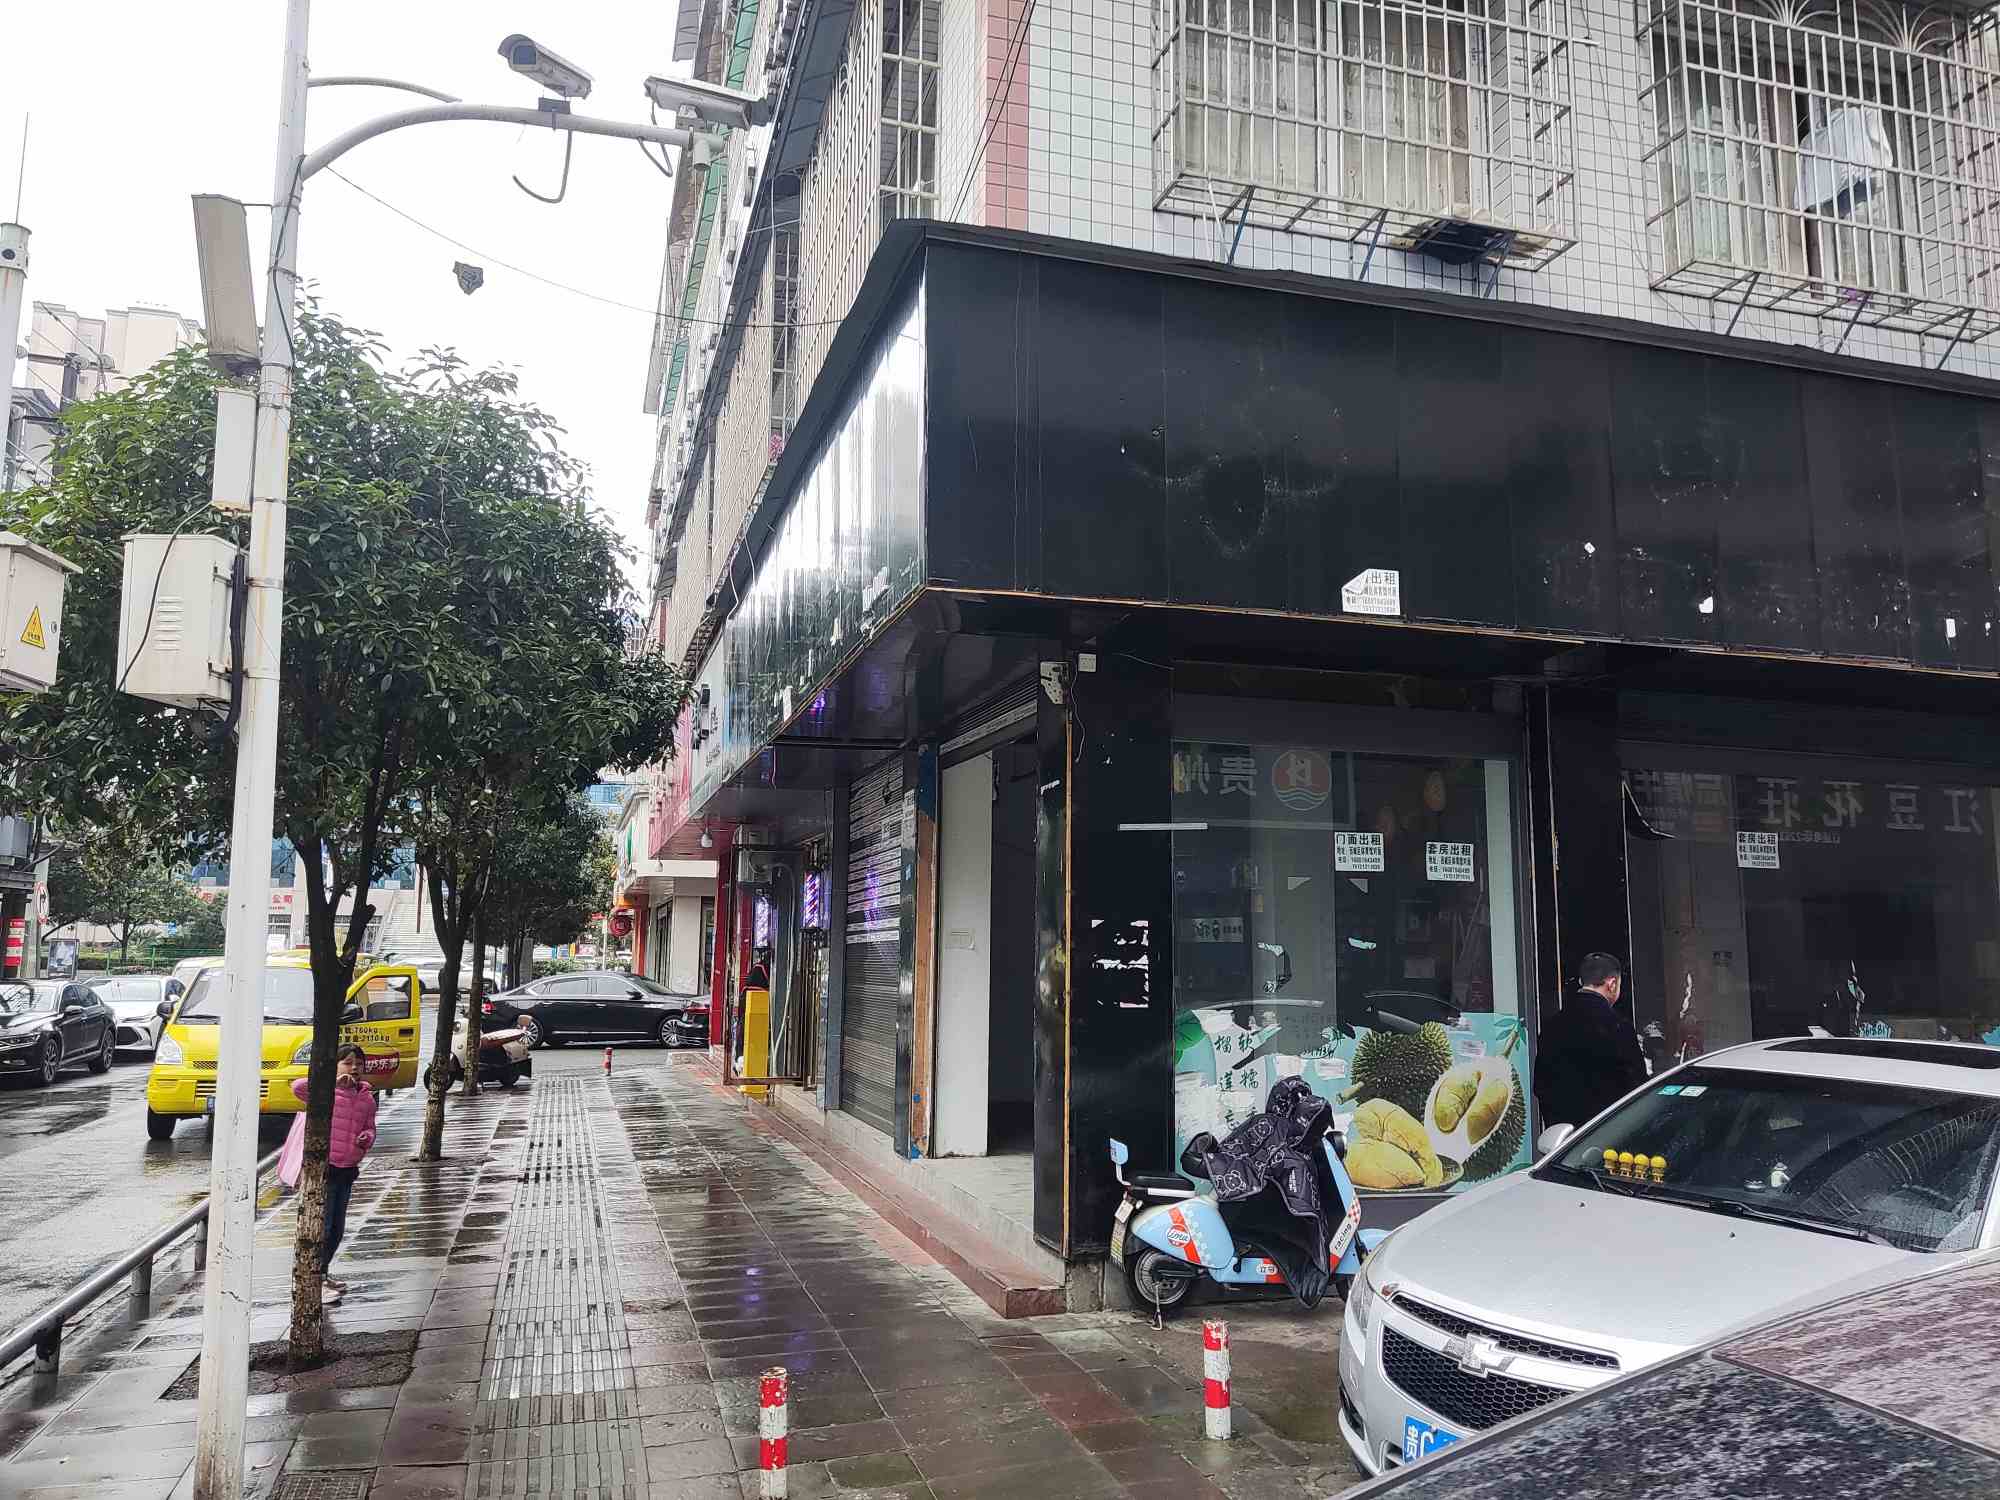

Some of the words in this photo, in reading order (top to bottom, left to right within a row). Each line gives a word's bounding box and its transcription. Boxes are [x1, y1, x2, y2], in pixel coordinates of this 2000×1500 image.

[1364, 570, 1397, 585] 出租
[1336, 833, 1381, 846] 门面出租
[1428, 843, 1471, 856] 套房出租
[1334, 1223, 1352, 1250] racing
